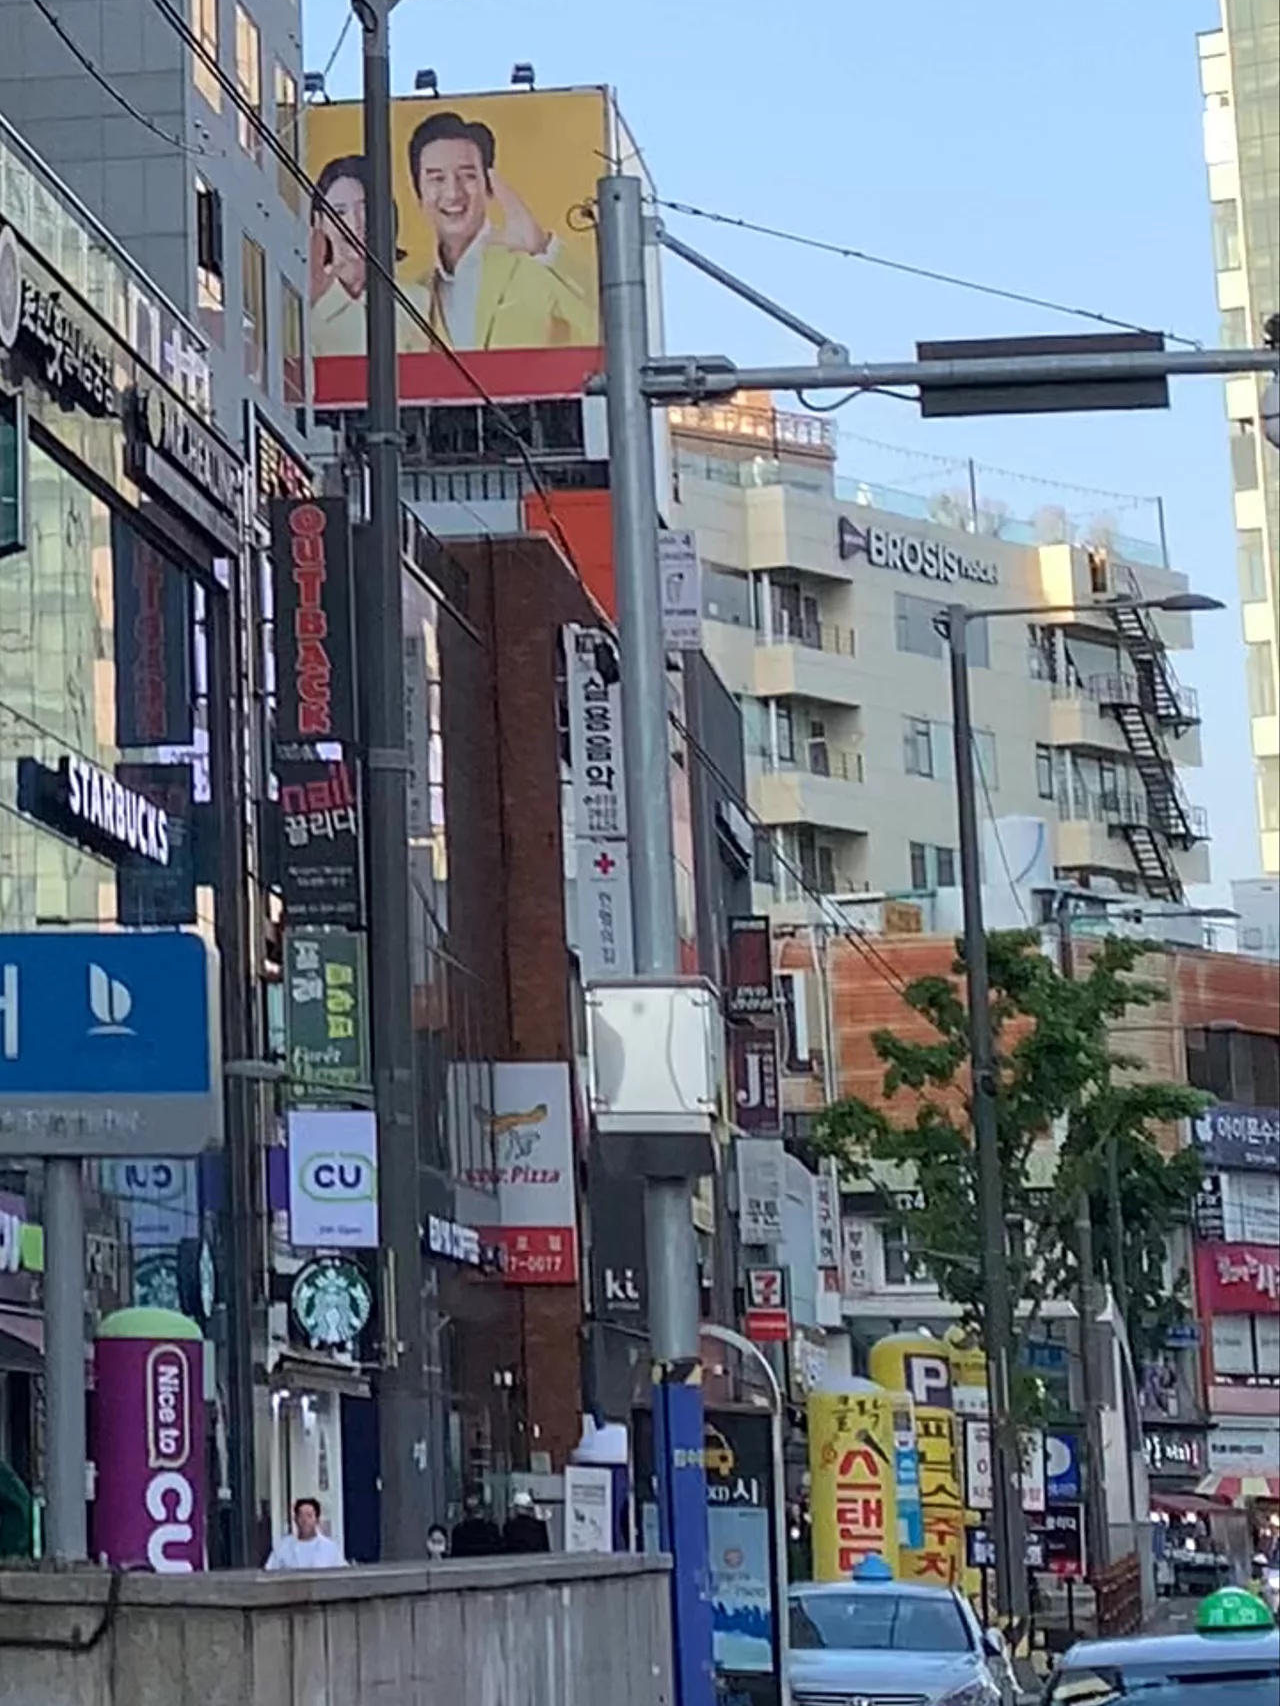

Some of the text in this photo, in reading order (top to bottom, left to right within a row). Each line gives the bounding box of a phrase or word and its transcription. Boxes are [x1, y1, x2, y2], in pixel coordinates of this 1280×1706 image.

[864, 528, 960, 585] BROSIS
[286, 503, 331, 738] OUTBACK
[66, 752, 169, 868] STARBUCKS
[312, 1162, 364, 1189] CU
[157, 1363, 180, 1456] Nice to
[145, 1470, 195, 1574] CU
